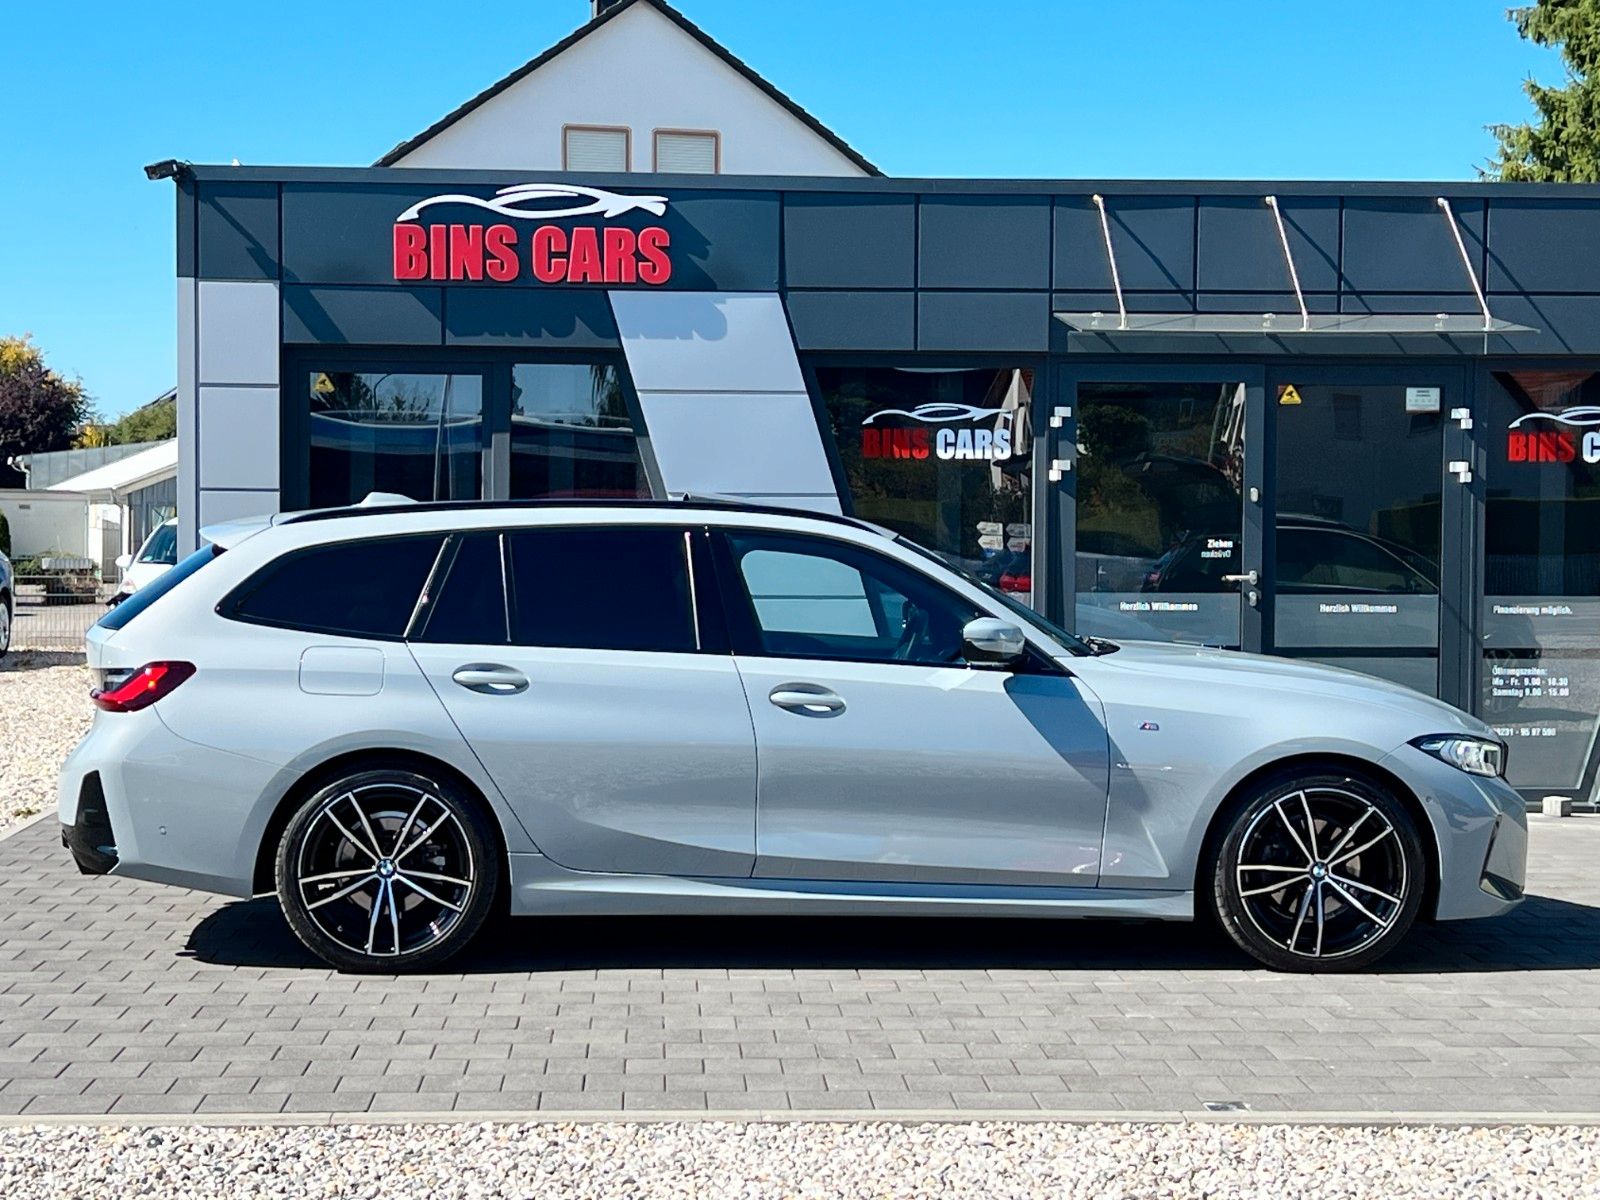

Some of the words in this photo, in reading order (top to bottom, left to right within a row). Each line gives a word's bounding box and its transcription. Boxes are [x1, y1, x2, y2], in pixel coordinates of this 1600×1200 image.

[393, 223, 519, 282] BINS
[532, 225, 672, 284] CARS
[862, 428, 930, 460] BINS
[936, 428, 1012, 460] CARS
[1508, 431, 1576, 463] BINS
[1207, 539, 1233, 548] Ziehen
[1120, 601, 1150, 611] Herzlich
[1151, 601, 1198, 611] Willkommen
[1319, 603, 1350, 613] Herzlich
[1350, 603, 1397, 613] Willkommen
[1493, 605, 1540, 615] Finanzierung
[1492, 688, 1524, 698] Samstag
